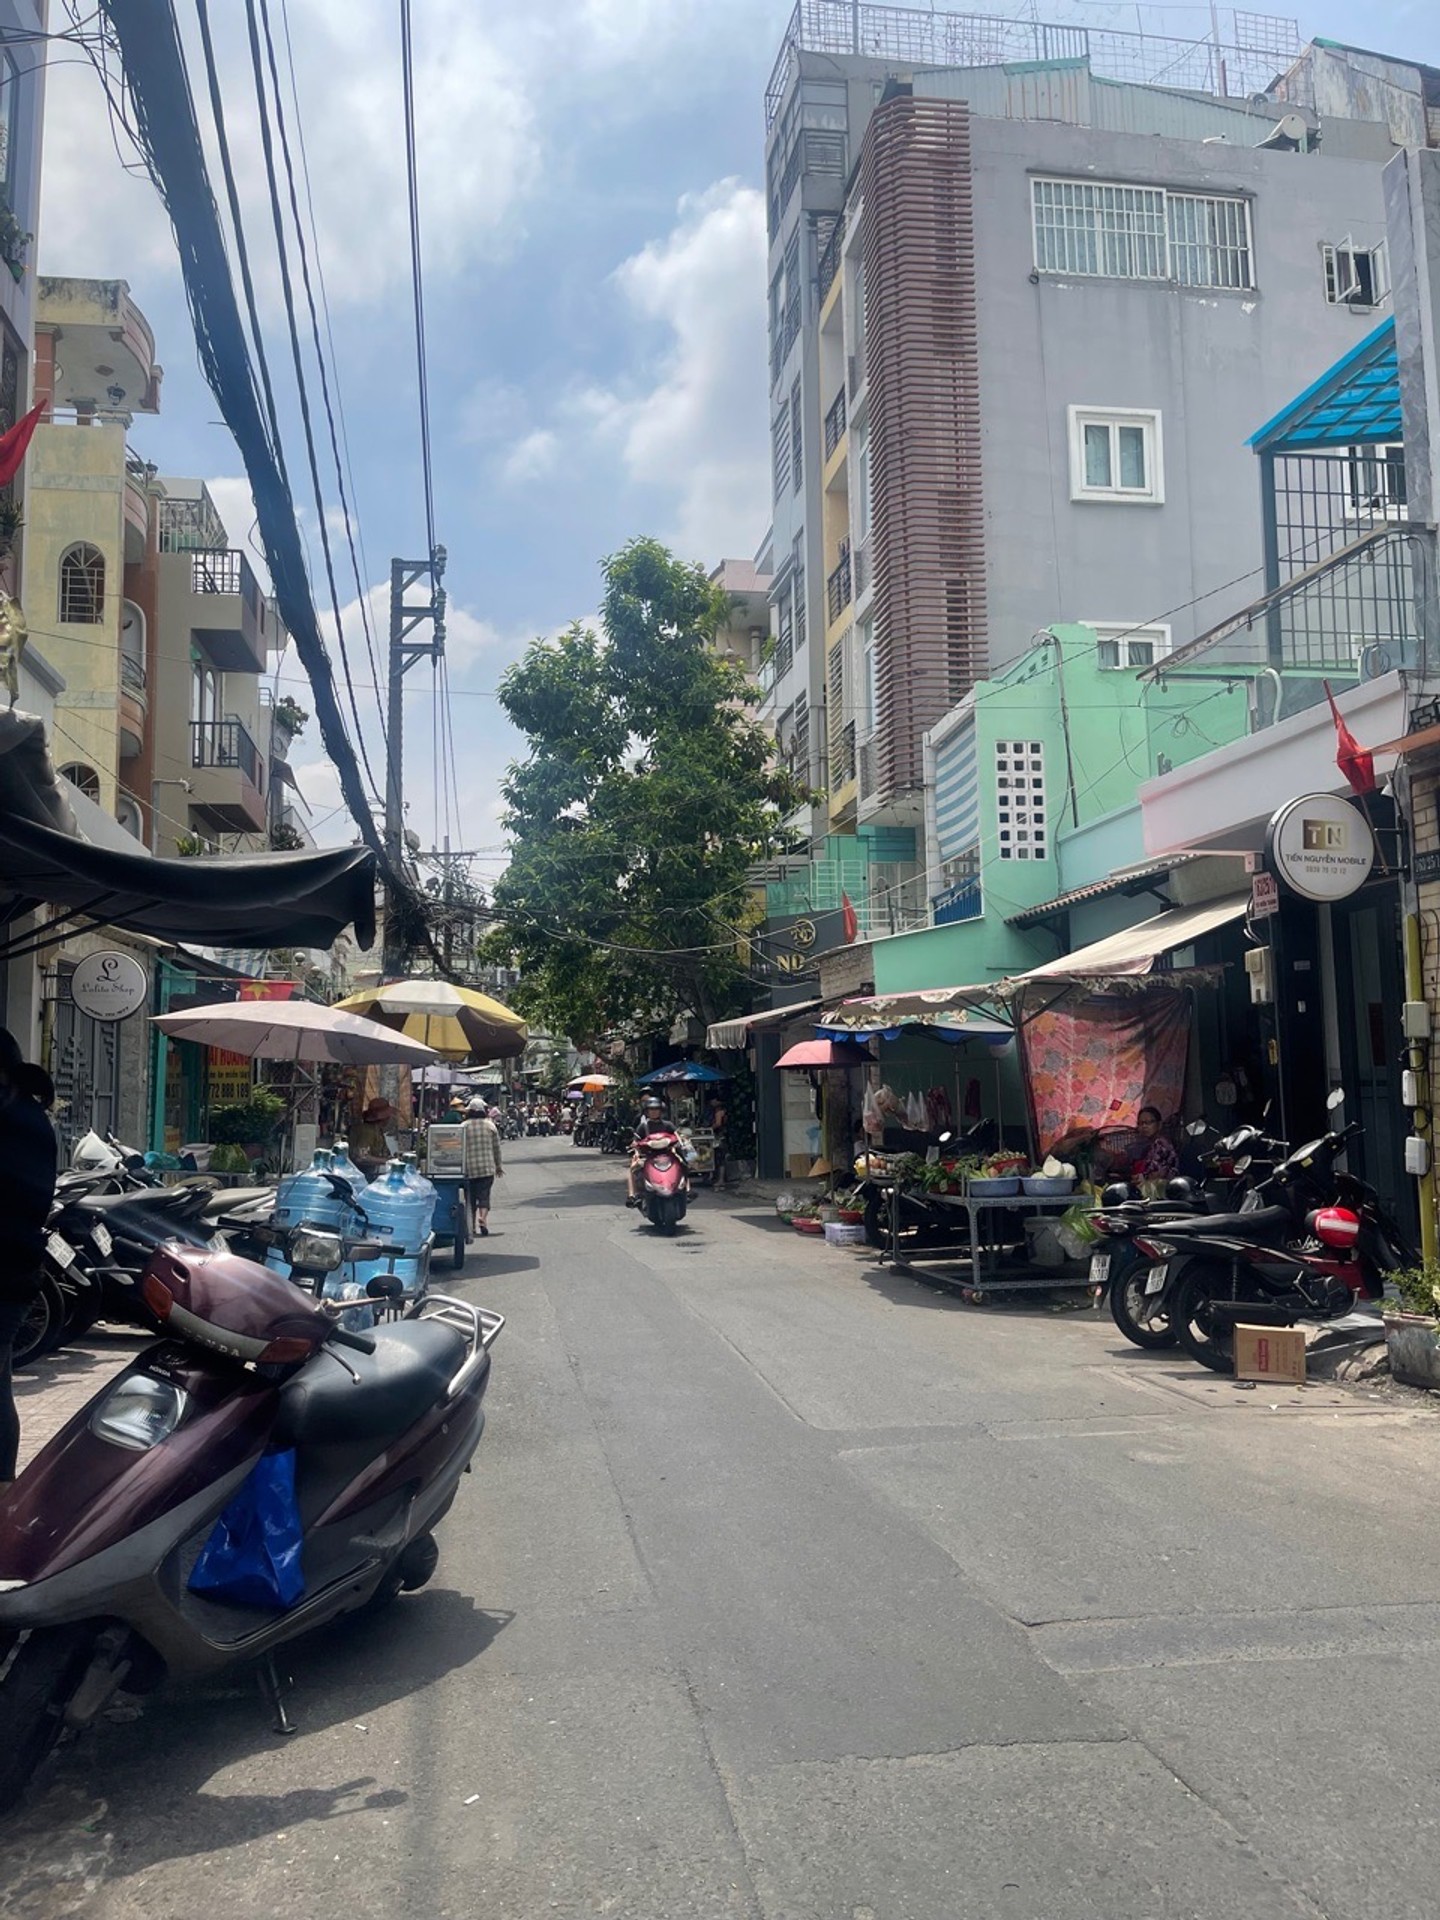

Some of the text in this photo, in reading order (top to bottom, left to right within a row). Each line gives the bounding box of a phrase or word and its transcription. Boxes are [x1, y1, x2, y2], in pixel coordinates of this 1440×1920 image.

[1307, 826, 1341, 845] TN
[1337, 856, 1366, 865] MOBILE
[111, 983, 135, 996] Shop
[149, 1365, 171, 1377] HONDA
